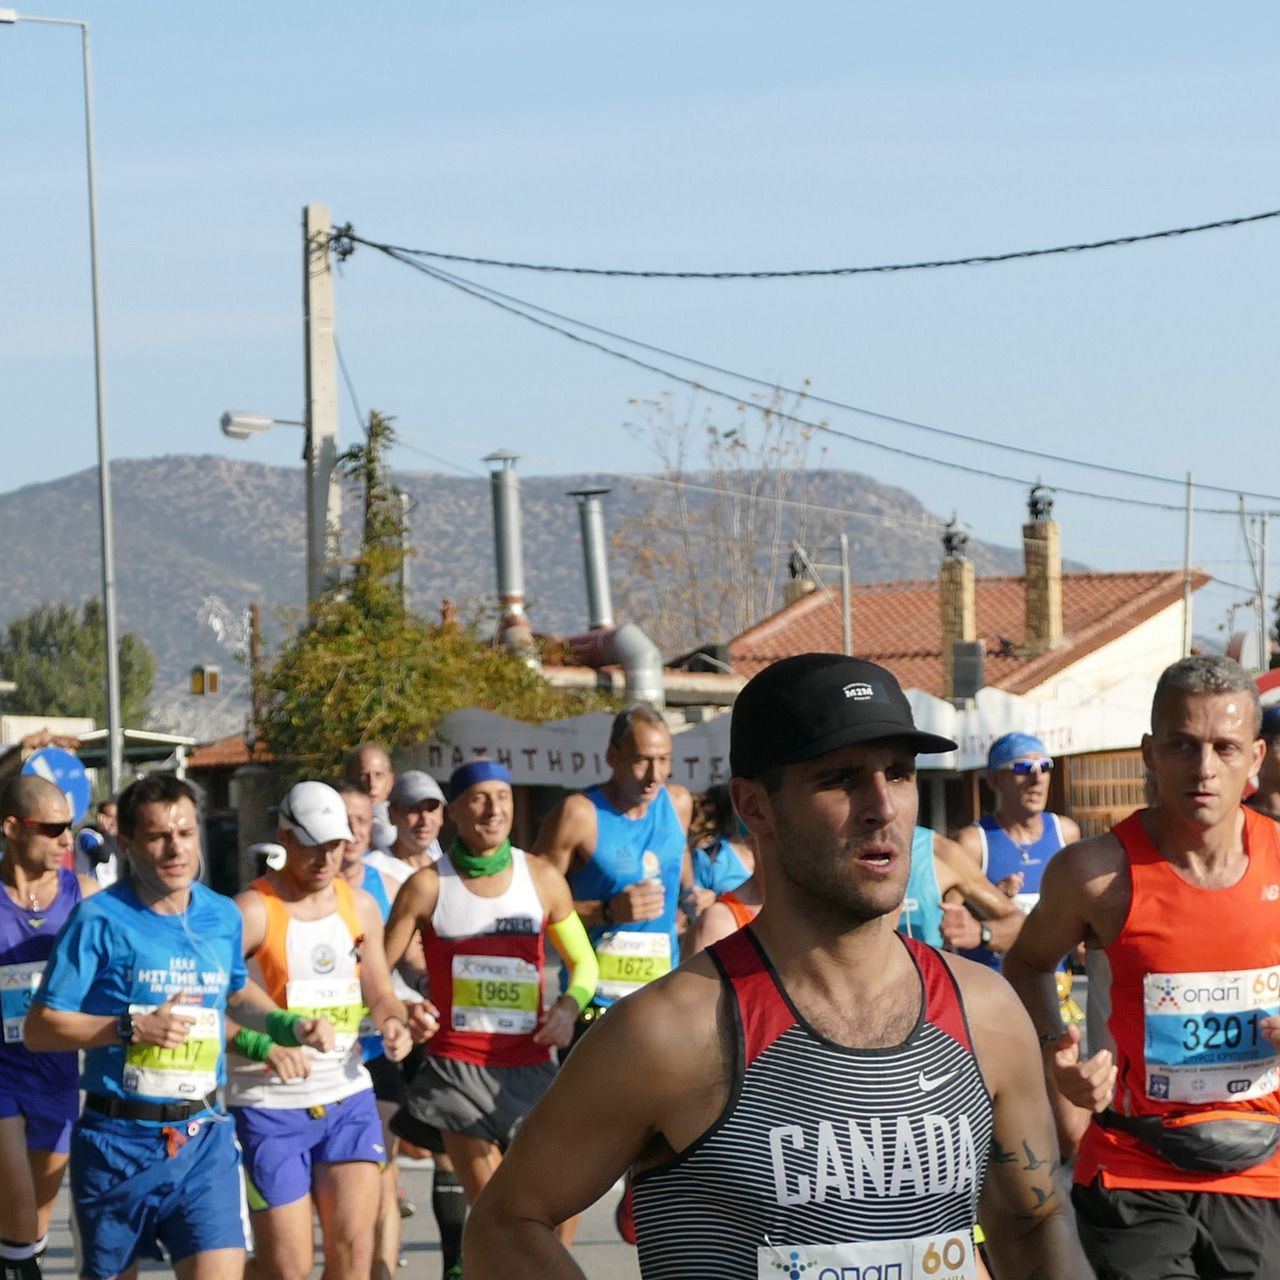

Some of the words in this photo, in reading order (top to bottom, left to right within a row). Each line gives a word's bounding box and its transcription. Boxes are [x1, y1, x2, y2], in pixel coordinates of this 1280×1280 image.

[169, 970, 199, 985] THE
[617, 957, 655, 977] 1672
[475, 981, 521, 1002] 1965
[1183, 987, 1240, 1003] οπαπ
[1252, 972, 1280, 995] 60
[1182, 1013, 1260, 1051] 3201
[769, 1114, 977, 1205] CANADA
[921, 1237, 966, 1275] 60
